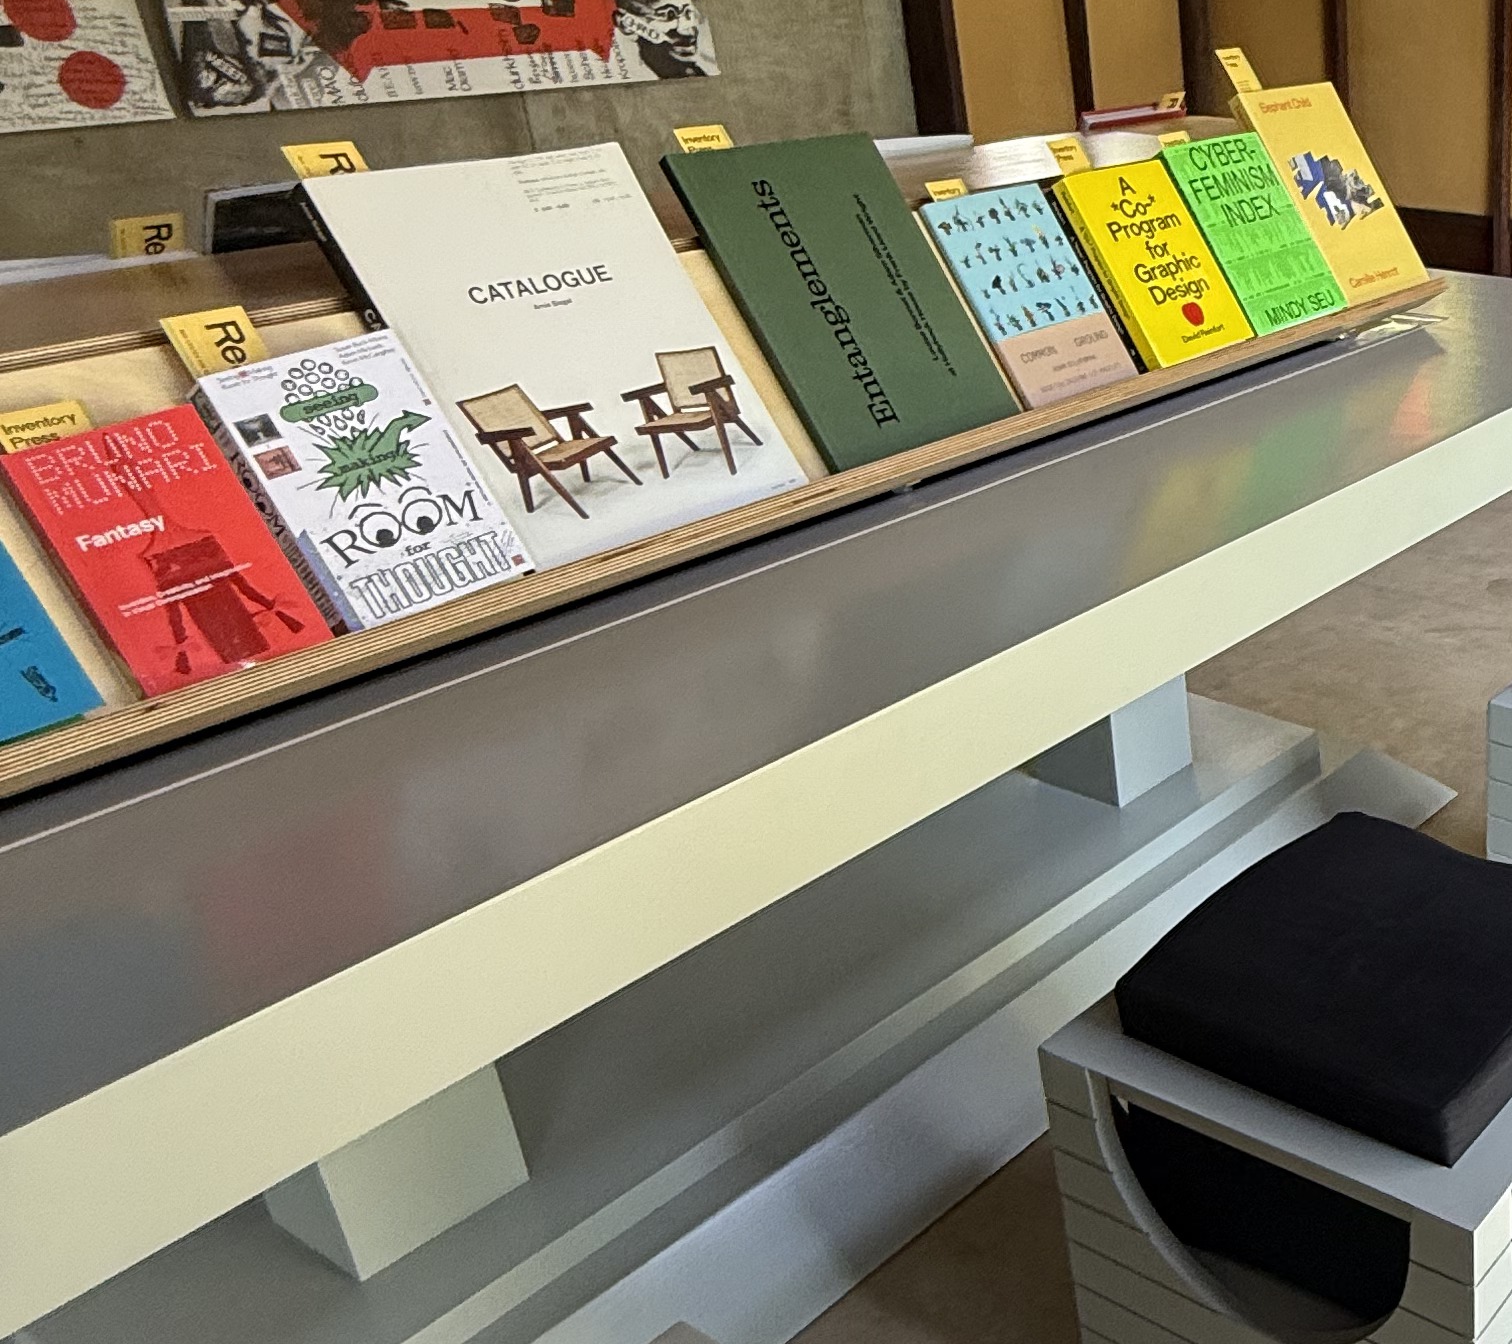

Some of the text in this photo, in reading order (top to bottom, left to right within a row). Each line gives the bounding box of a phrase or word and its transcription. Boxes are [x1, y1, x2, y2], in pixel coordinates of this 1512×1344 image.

[1188, 138, 1257, 172] CYBER-
[1118, 176, 1137, 197] A
[1187, 164, 1281, 205] FEMINISM
[1105, 212, 1182, 243] Program
[1219, 193, 1281, 228] INDEX
[142, 222, 174, 255] Re
[1145, 240, 1169, 260] for
[467, 264, 614, 305] CATALOGUE
[1133, 254, 1201, 284] Graphic
[751, 178, 901, 429] Entanglements
[1148, 276, 1211, 306] Design
[1264, 287, 1337, 327] MINDY SEU
[204, 319, 247, 366] Re
[302, 393, 361, 416] seeing
[0, 413, 77, 436] Inventory
[24, 419, 179, 486] BRUNO
[44, 442, 218, 516] MUNARI
[75, 514, 166, 552] Fantasy
[320, 489, 484, 569] ROOM
[405, 541, 432, 557] for
[351, 529, 513, 620] THOUGHT
